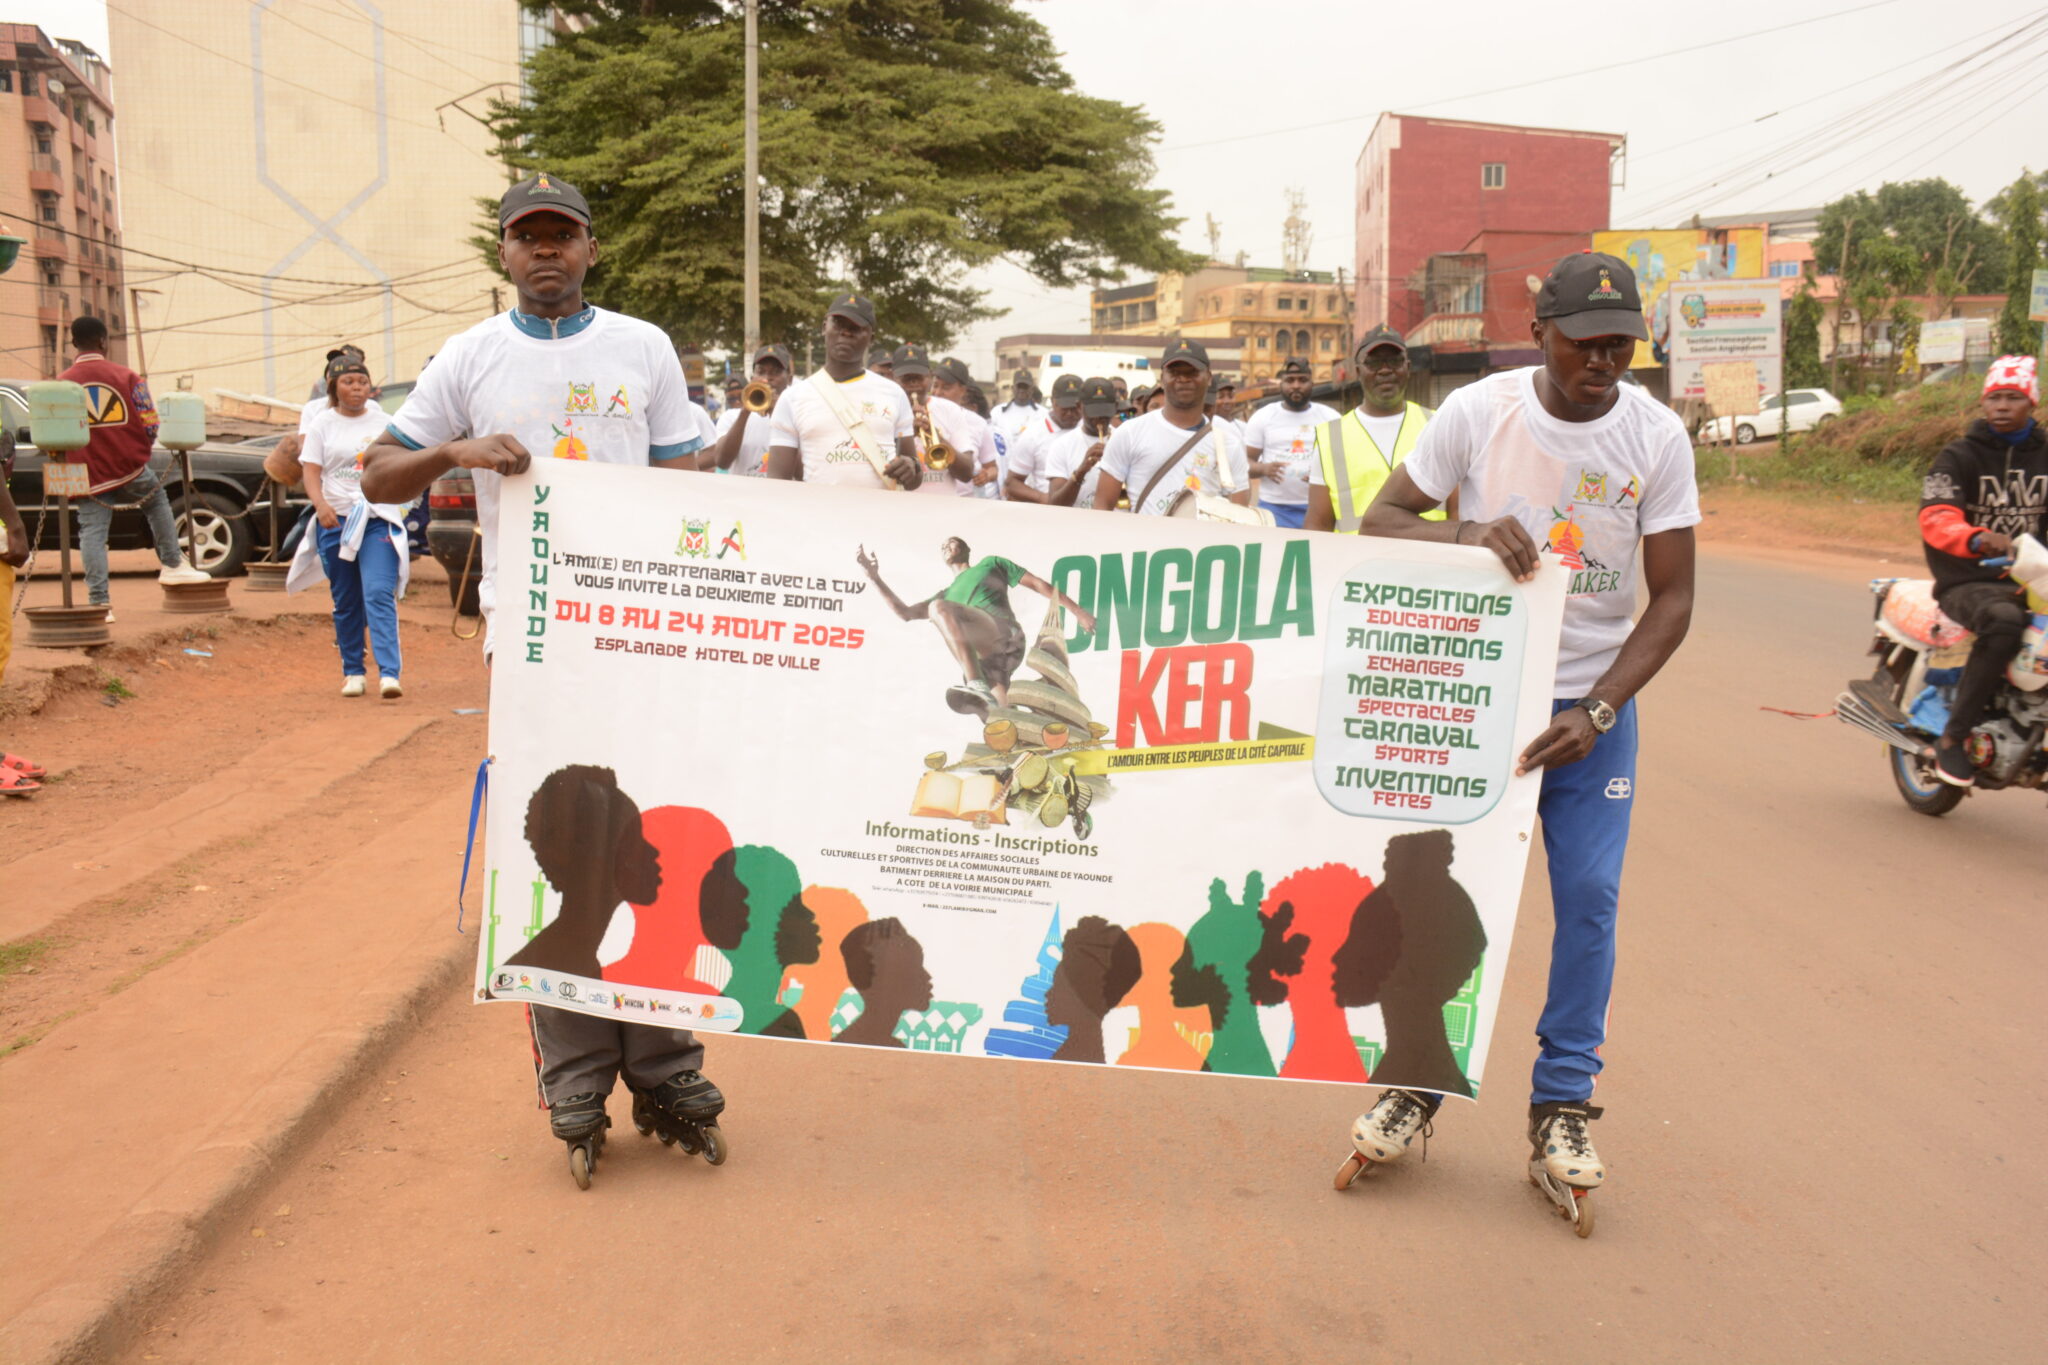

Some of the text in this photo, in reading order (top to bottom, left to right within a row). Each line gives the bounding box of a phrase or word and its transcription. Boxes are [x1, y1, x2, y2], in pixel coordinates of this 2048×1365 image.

[525, 484, 551, 664] YAOUNDE
[621, 559, 642, 573] EN
[646, 561, 757, 584] PARTENARIAT
[760, 572, 803, 589] AVEC
[806, 576, 826, 591] LA
[831, 578, 866, 594] CUY
[573, 572, 843, 612] VOUS INVITE LA DEUXIEME EDITION
[1050, 539, 1315, 654] ONGOLA
[1343, 581, 1512, 617] EXPOSITIONS
[554, 599, 864, 649] DU 8 AU 24 AOUT 2025
[1366, 608, 1481, 633] EDUCATIONS
[593, 636, 820, 671] ESPLANADE HOTEL DE VILLE
[1346, 627, 1504, 661] ANIMATIONS
[1366, 655, 1465, 678] ECHANGES
[1115, 642, 1255, 750] KER
[1346, 673, 1492, 707] MARATHON
[1357, 698, 1476, 724] SPECTACLES
[1343, 717, 1480, 750] CARNAVAL
[1107, 743, 1305, 768] L'AMOUR ENTRE LES PEUPLES DE LA CITÉ CAPITALE
[1374, 744, 1450, 766] SPORTS
[1334, 765, 1488, 798] INVENTIONS
[1372, 790, 1433, 810] FETES
[865, 819, 980, 846] Informations
[994, 832, 1098, 857] Inscriptions
[895, 844, 1039, 865] DIRECTION DES AFFAIRES SOCIALES
[820, 848, 1112, 883] CULTURELLES ET SPORTIVES DE LA COMMUNAUTE URBAINE DE YAOUNDE
[879, 865, 1051, 888] BATIMENT DERRIERE LA MAISON DU PARTI.
[903, 879, 925, 887] COTE
[928, 880, 940, 888] DE
[941, 881, 951, 889] LA
[953, 882, 981, 892] VOIRIE
[982, 885, 1032, 897] MUNICIPALE
